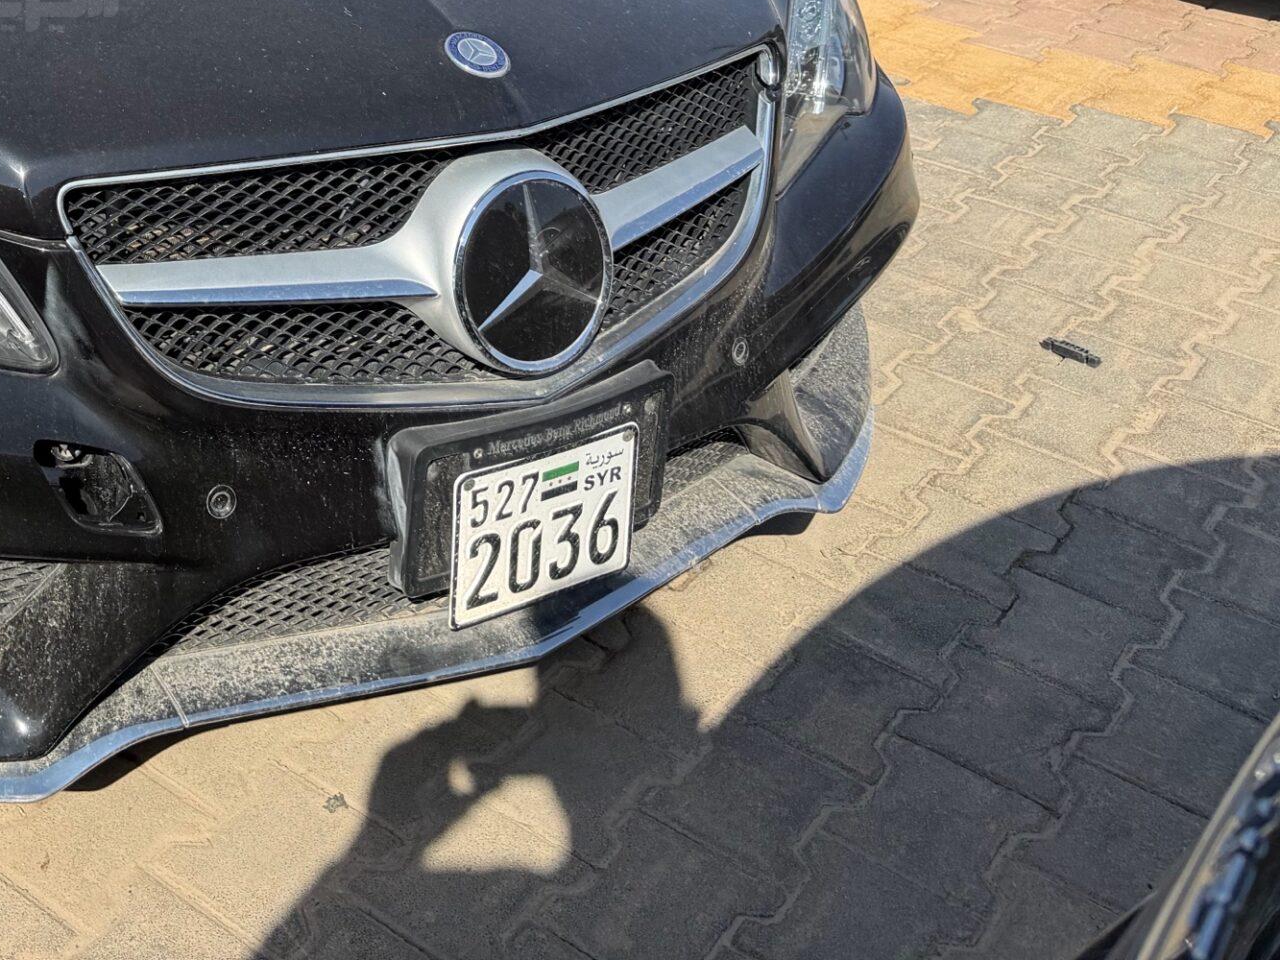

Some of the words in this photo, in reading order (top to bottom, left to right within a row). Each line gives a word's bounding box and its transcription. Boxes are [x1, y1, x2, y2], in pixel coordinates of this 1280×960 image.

[585, 448, 624, 467] سورية
[470, 471, 540, 529] 527
[583, 466, 622, 492] SYR
[466, 490, 620, 610] 2036
